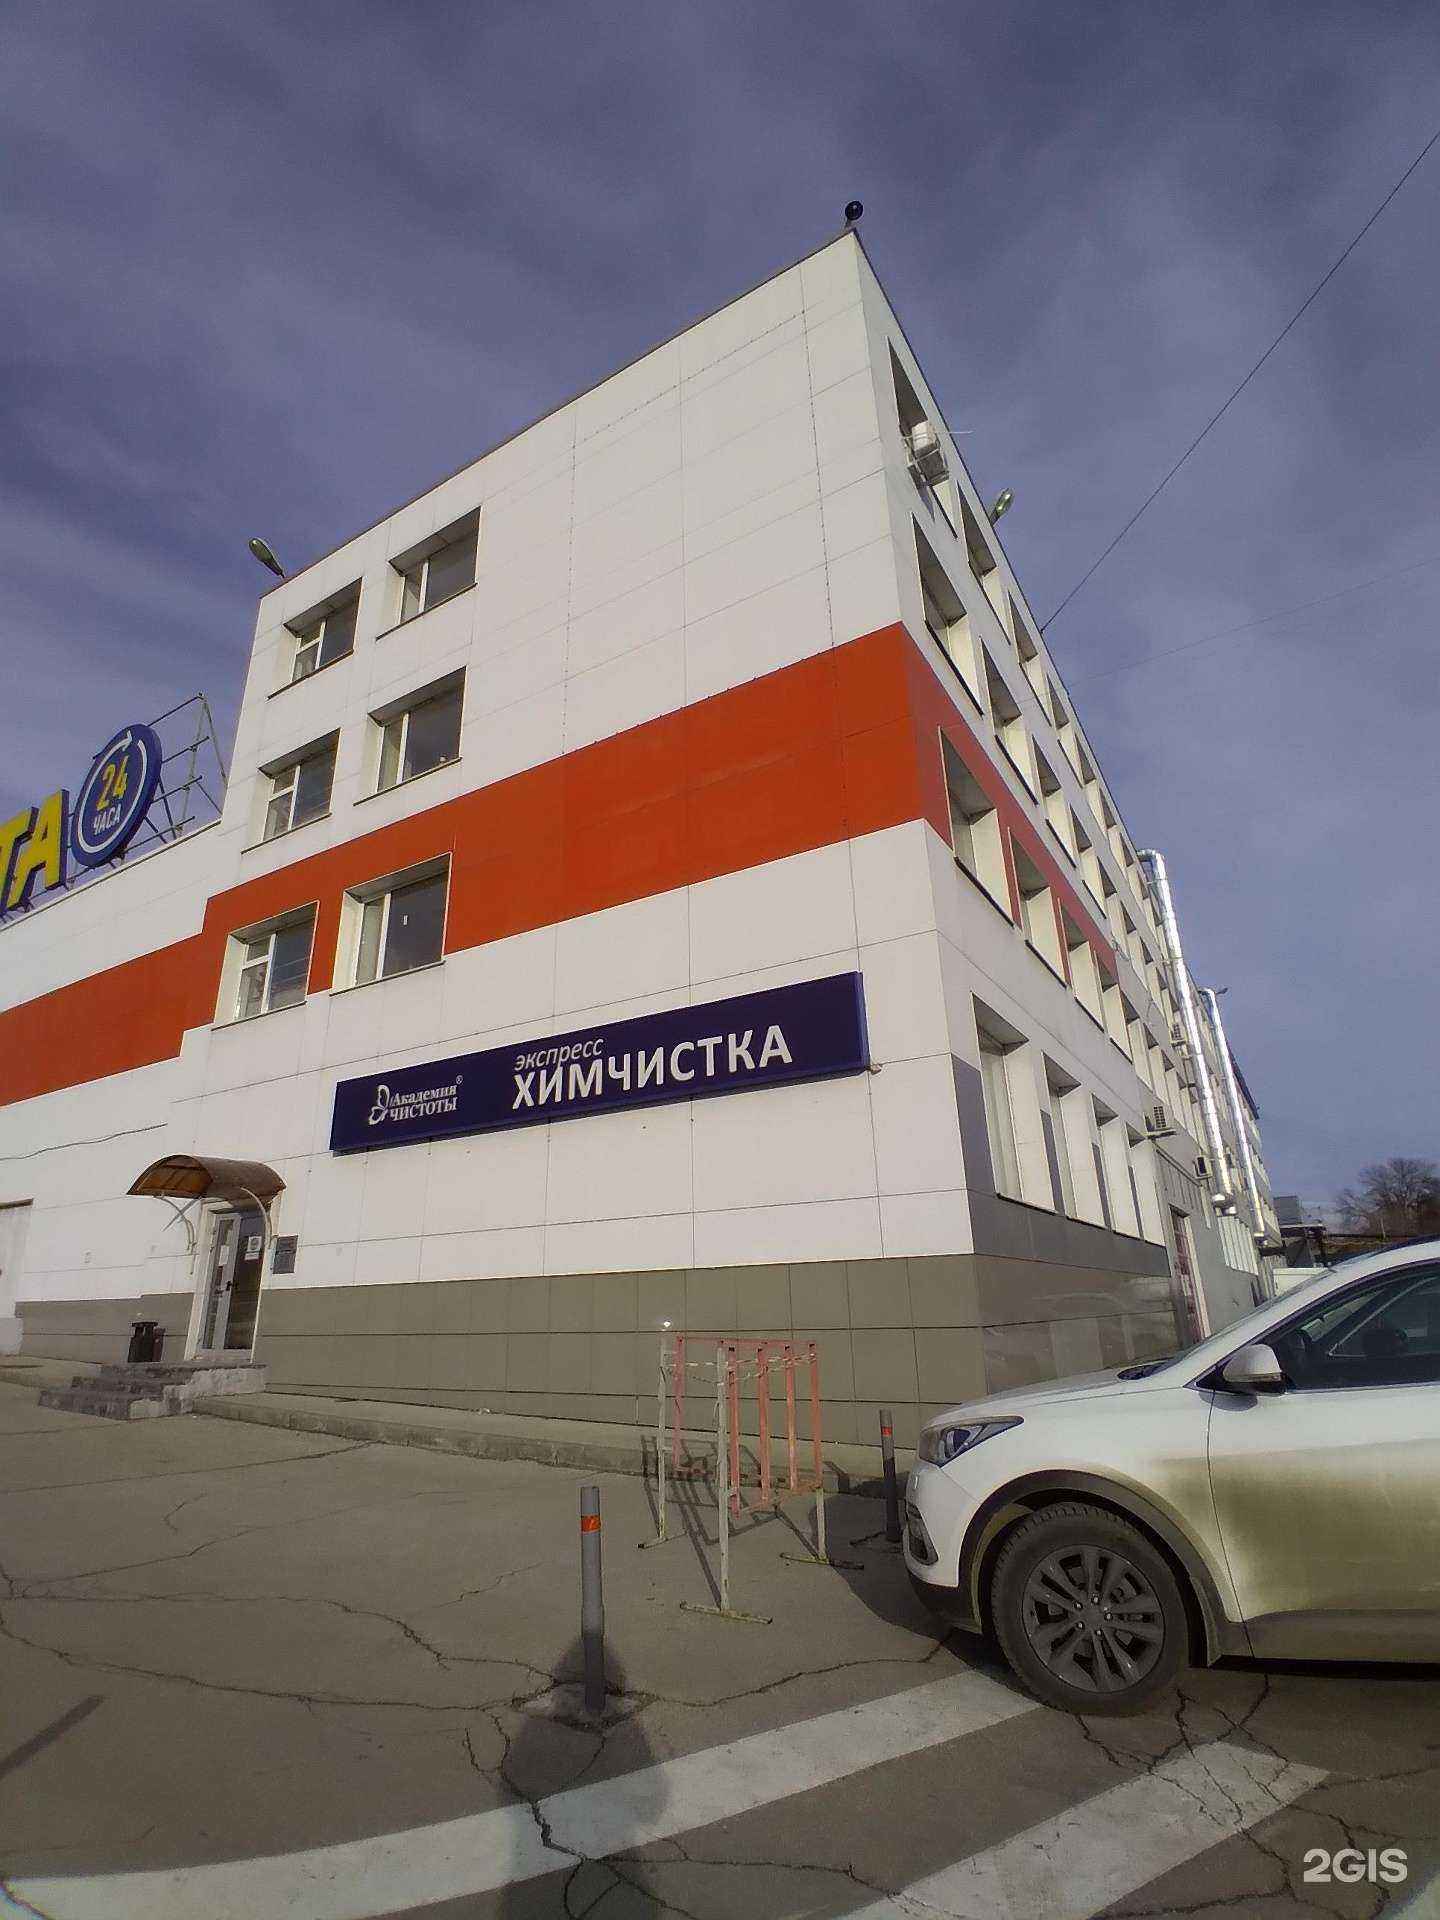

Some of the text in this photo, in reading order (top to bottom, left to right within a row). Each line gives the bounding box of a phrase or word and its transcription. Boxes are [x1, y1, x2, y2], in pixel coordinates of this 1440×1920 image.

[96, 755, 129, 811] 24
[94, 803, 121, 835] ЧАСА
[512, 1024, 793, 1110] ХИМЧИСТКА
[514, 1038, 604, 1071] экспресс
[390, 1096, 458, 1121] ЧИСТОТЫ
